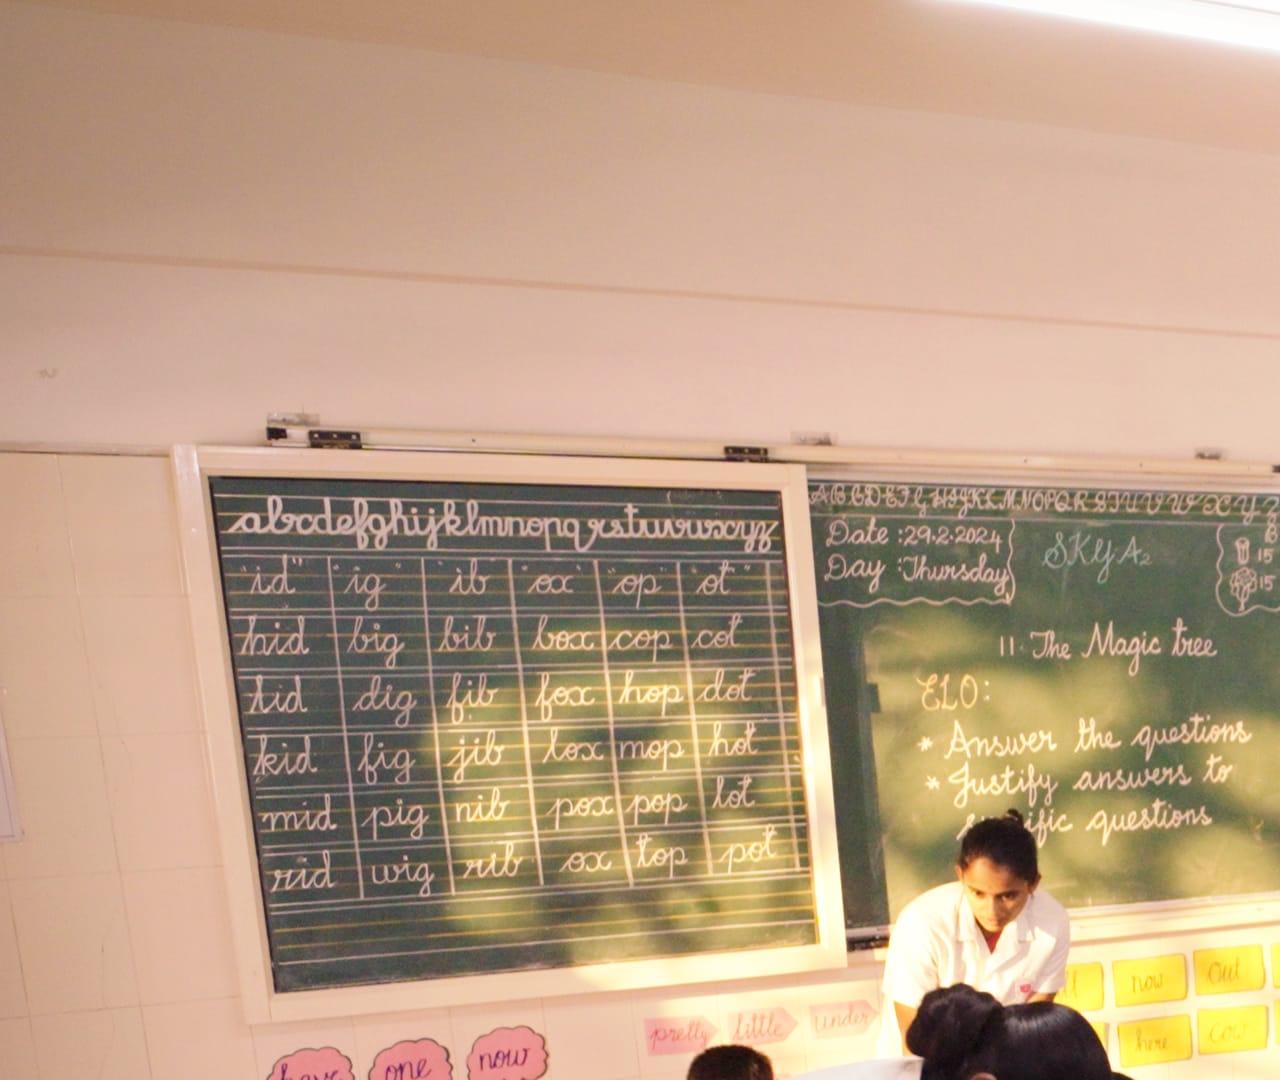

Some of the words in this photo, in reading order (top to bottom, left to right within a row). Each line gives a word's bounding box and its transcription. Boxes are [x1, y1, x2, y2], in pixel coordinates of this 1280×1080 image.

[826, 516, 889, 547] Date
[1257, 548, 1273, 564] 15
[824, 553, 886, 594] Day
[1259, 575, 1276, 591] 15
[241, 615, 310, 656] hid
[347, 615, 405, 669] big
[437, 614, 497, 652] bib
[532, 615, 596, 651] box
[610, 628, 673, 663] cop
[692, 612, 743, 648] cot
[1029, 629, 1072, 660] The
[1081, 620, 1163, 677] Magic
[1170, 616, 1218, 657] tree
[352, 676, 417, 727] dig
[447, 673, 498, 724] fib
[536, 672, 596, 722] fox
[619, 671, 685, 717] hop
[697, 669, 757, 703] dot
[253, 735, 318, 775] kid
[357, 734, 416, 785] fig
[447, 732, 505, 783] jib
[619, 739, 686, 772] mop
[707, 722, 759, 758] hot
[945, 720, 1057, 760] Answer
[1074, 717, 1121, 754] the
[1130, 714, 1252, 762] questions
[262, 794, 338, 832] mid
[361, 799, 430, 840] pig
[455, 787, 511, 823] nib
[547, 794, 614, 829] pox
[625, 791, 688, 827] pop
[711, 776, 757, 811] lot
[948, 761, 1059, 809] Justify
[1073, 761, 1193, 792] answers
[1203, 754, 1234, 784] to
[956, 812, 1073, 848] sific
[1085, 797, 1213, 847] questions
[270, 851, 337, 893] rid
[370, 855, 436, 897] wig
[462, 842, 523, 880] rib
[560, 848, 613, 874] ox
[635, 834, 689, 879] top
[720, 825, 781, 873] pot
[479, 1047, 532, 1071] now
